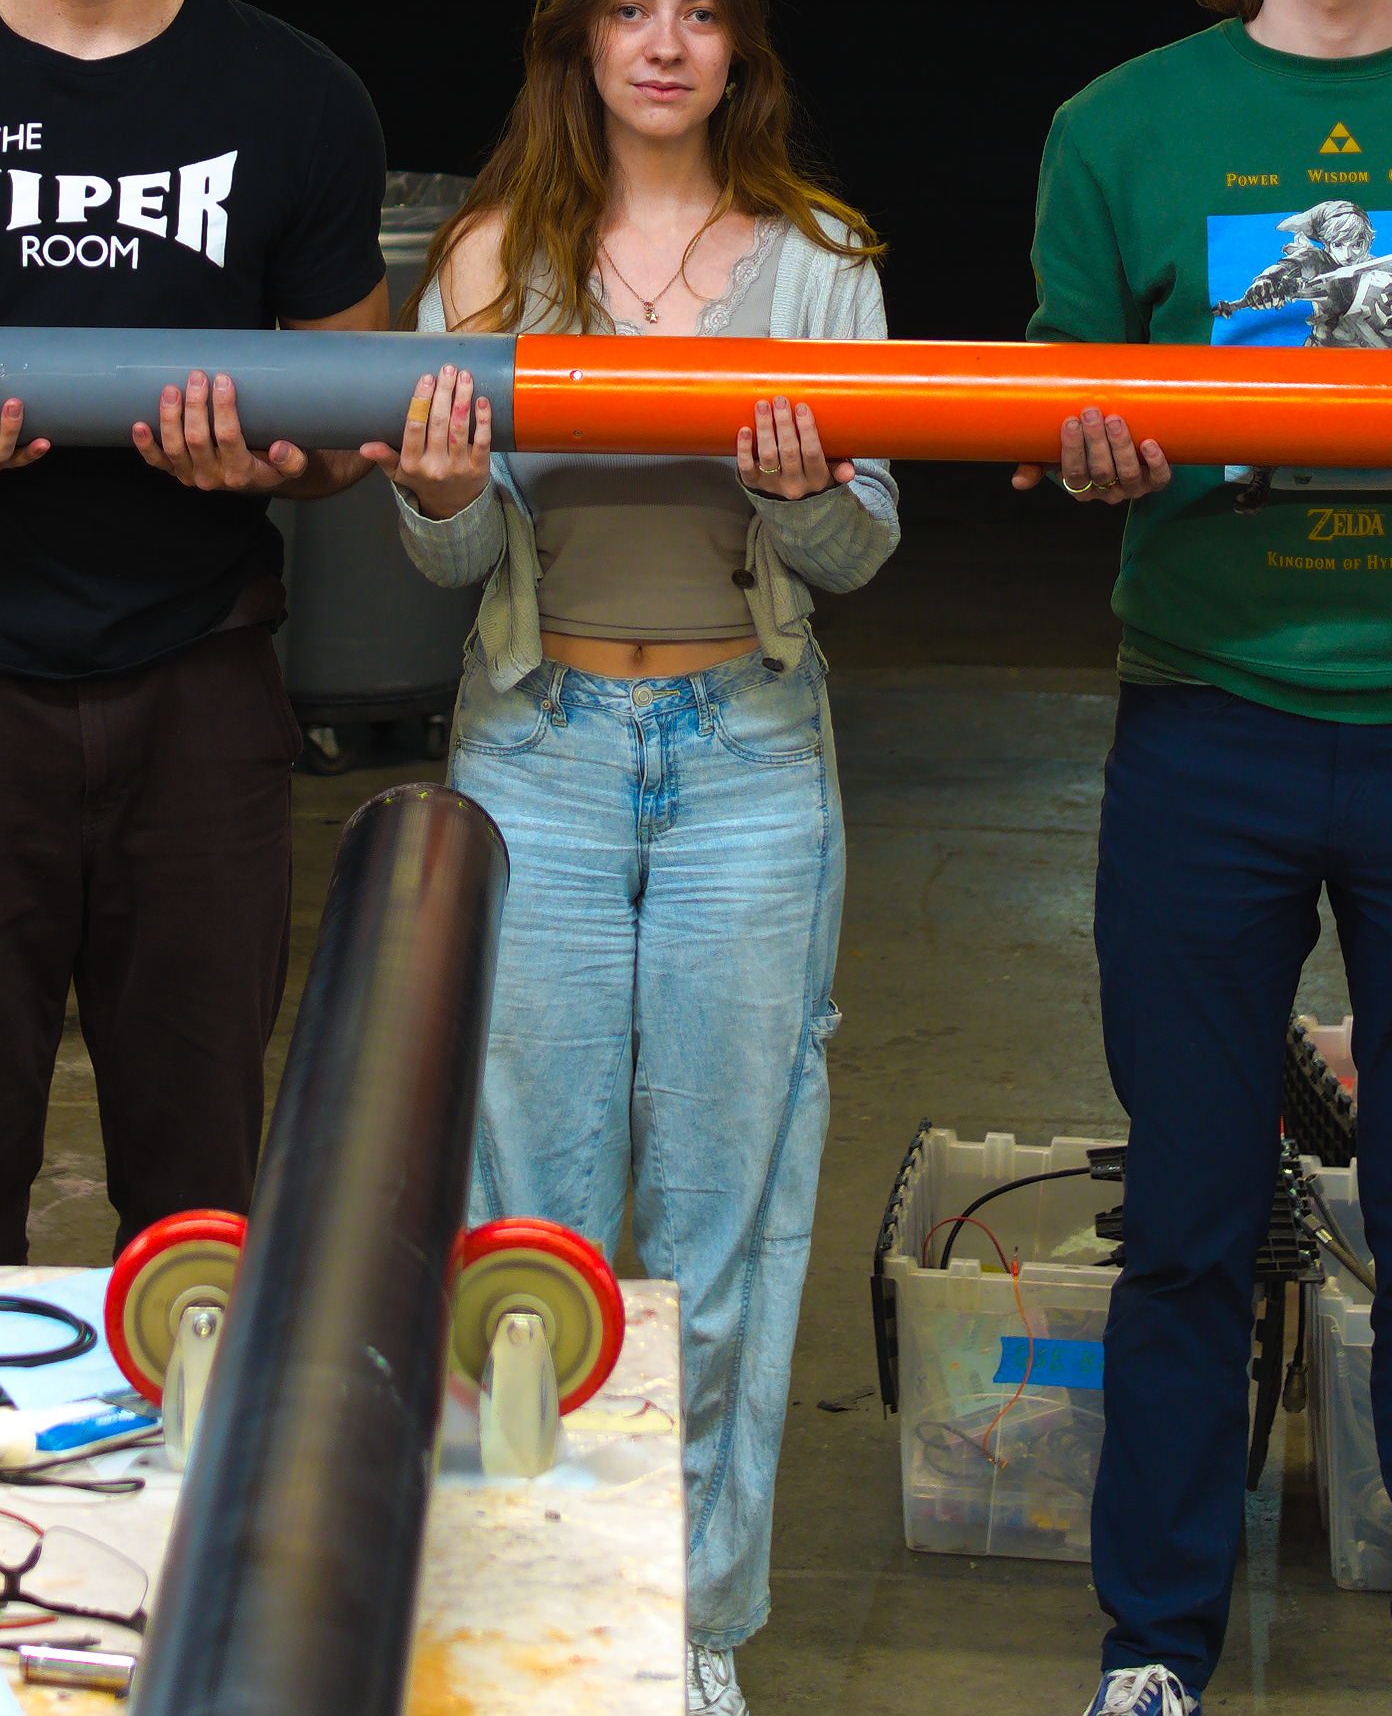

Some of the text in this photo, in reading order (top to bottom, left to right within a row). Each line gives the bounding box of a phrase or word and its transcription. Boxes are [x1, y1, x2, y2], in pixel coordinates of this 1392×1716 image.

[1225, 172, 1279, 187] POWER
[1307, 168, 1370, 183] WISDOM
[21, 234, 140, 270] ROOM
[1306, 508, 1386, 541] ZELDA
[1266, 550, 1336, 571] KINGDOM
